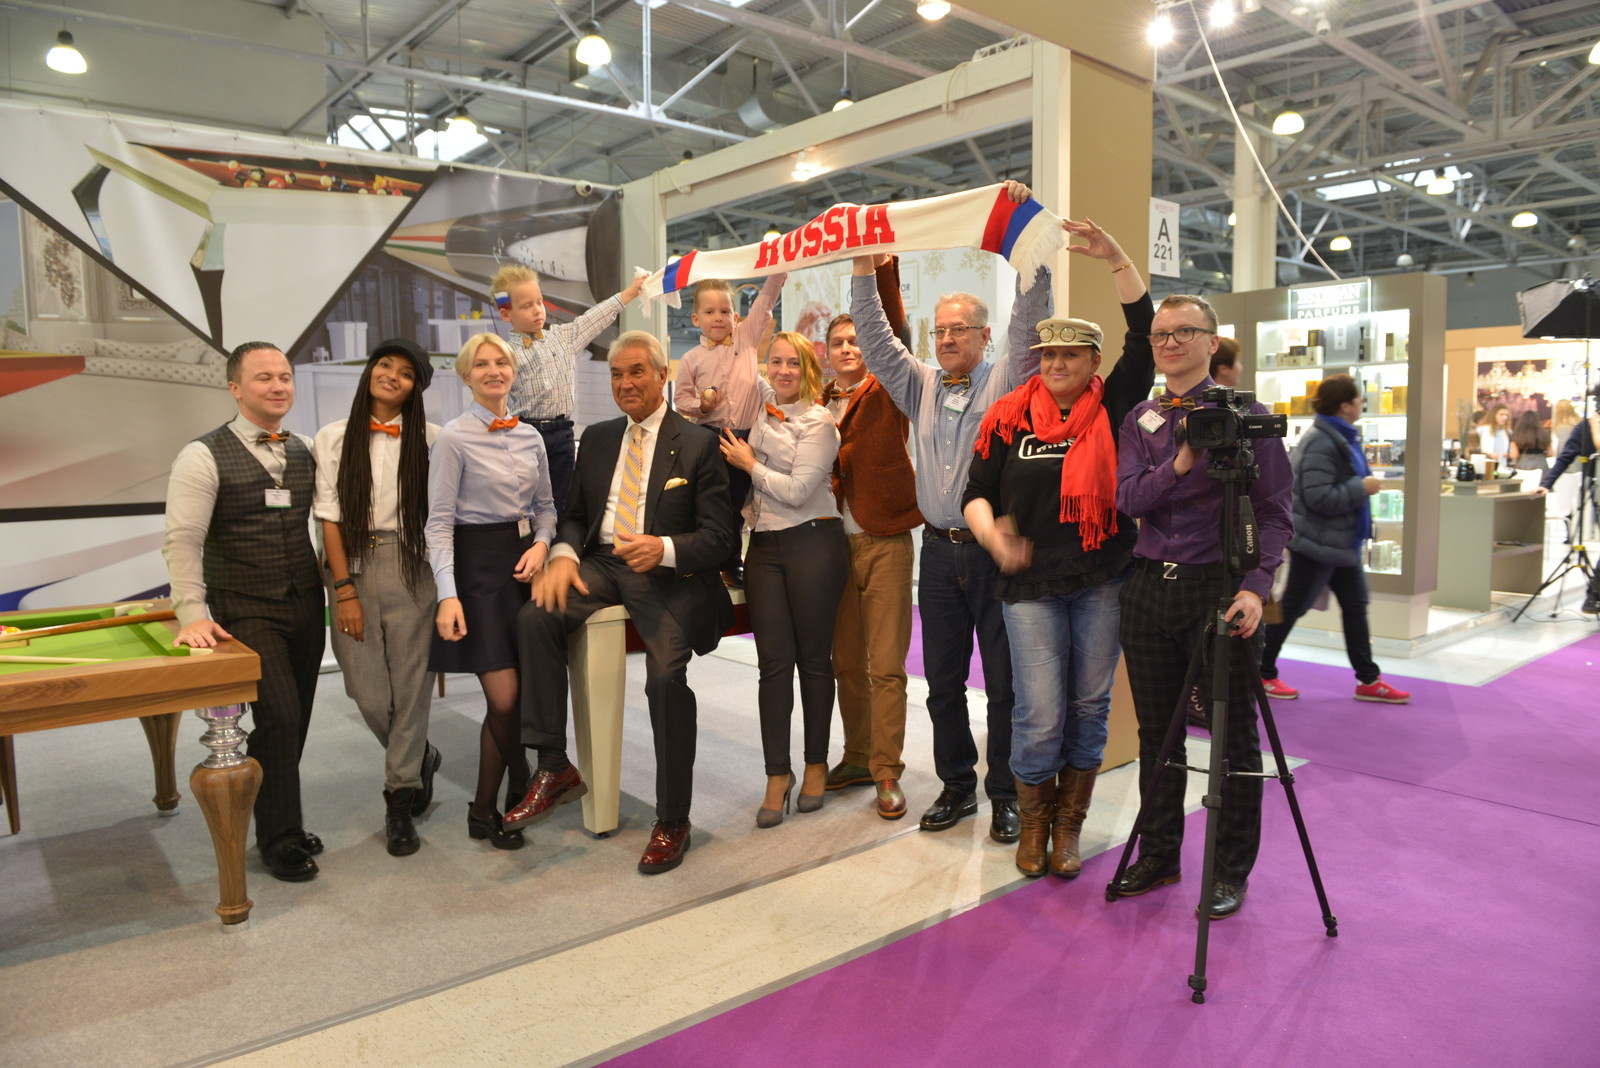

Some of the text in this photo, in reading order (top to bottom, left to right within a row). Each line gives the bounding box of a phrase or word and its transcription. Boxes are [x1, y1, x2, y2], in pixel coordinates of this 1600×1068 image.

[754, 204, 895, 269] RUSSIA
[1158, 218, 1170, 242] A
[1153, 243, 1173, 261] 221
[1297, 304, 1360, 319] PARFUMS
[1245, 524, 1254, 554] Canon
[1163, 561, 1178, 580] Z
